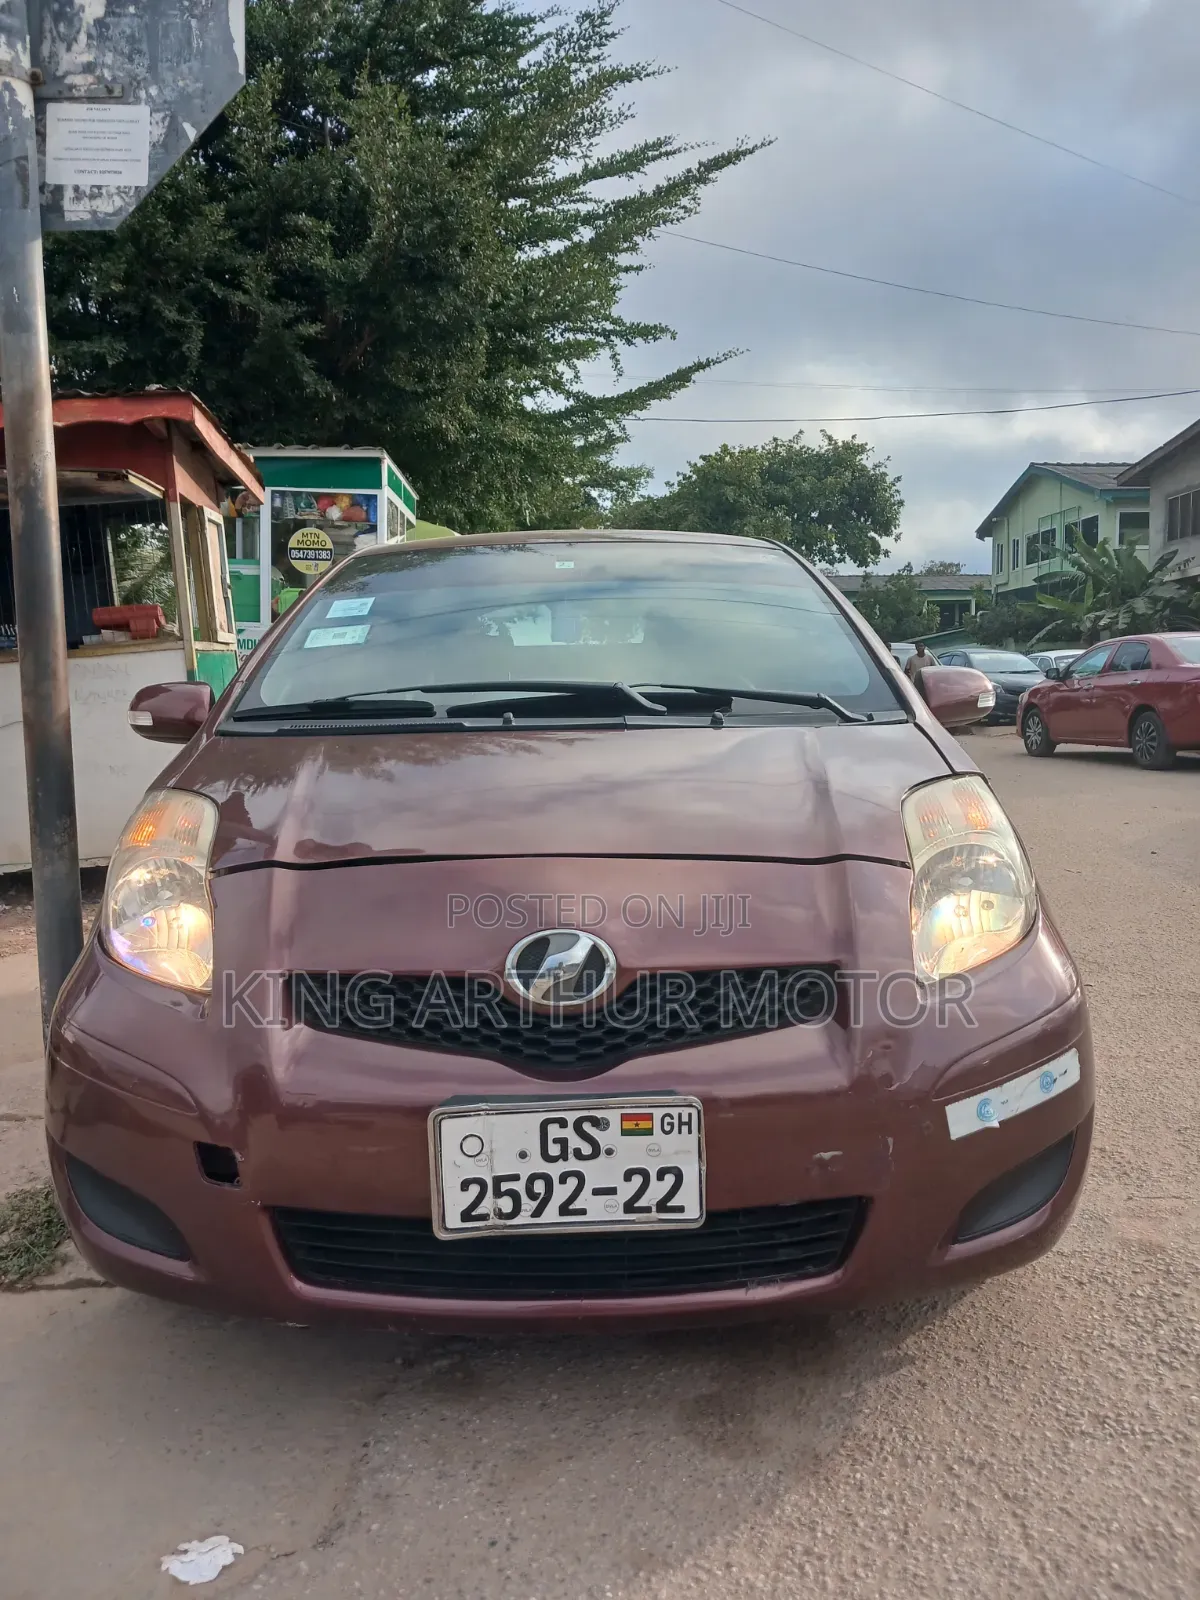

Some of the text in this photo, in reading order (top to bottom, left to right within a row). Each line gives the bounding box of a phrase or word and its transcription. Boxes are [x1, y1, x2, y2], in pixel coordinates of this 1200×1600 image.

[290, 549, 331, 560] 0547391383
[296, 539, 327, 547] MOMO
[660, 1112, 693, 1136] GH
[539, 1114, 602, 1164] GS
[460, 1165, 686, 1223] 2592-22
